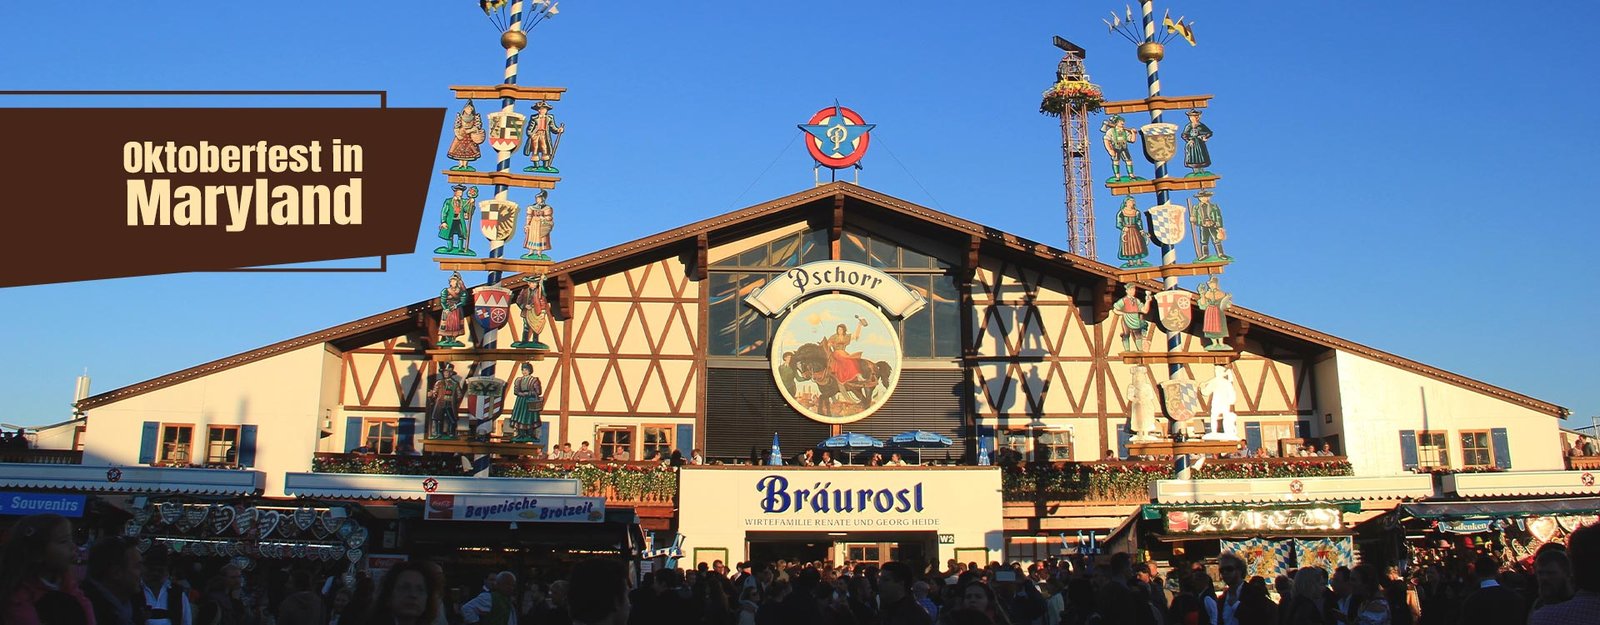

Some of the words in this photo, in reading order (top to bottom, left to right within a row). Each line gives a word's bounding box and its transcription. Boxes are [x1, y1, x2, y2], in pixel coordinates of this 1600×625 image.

[787, 265, 883, 294] Pschorr
[756, 475, 925, 514] Bräurosl
[10, 496, 79, 512] Souvenirs
[465, 497, 538, 519] Bayerische
[539, 501, 594, 520] Brotzeit
[744, 518, 812, 526] WIRTEFAMILIE
[814, 518, 851, 526] RENATE
[853, 518, 874, 526] UND
[875, 518, 910, 526] GEORG
[911, 517, 941, 526] HEIDE
[1261, 511, 1335, 528] Sezialit
[1446, 522, 1487, 531] denken
[939, 535, 954, 543] W2
